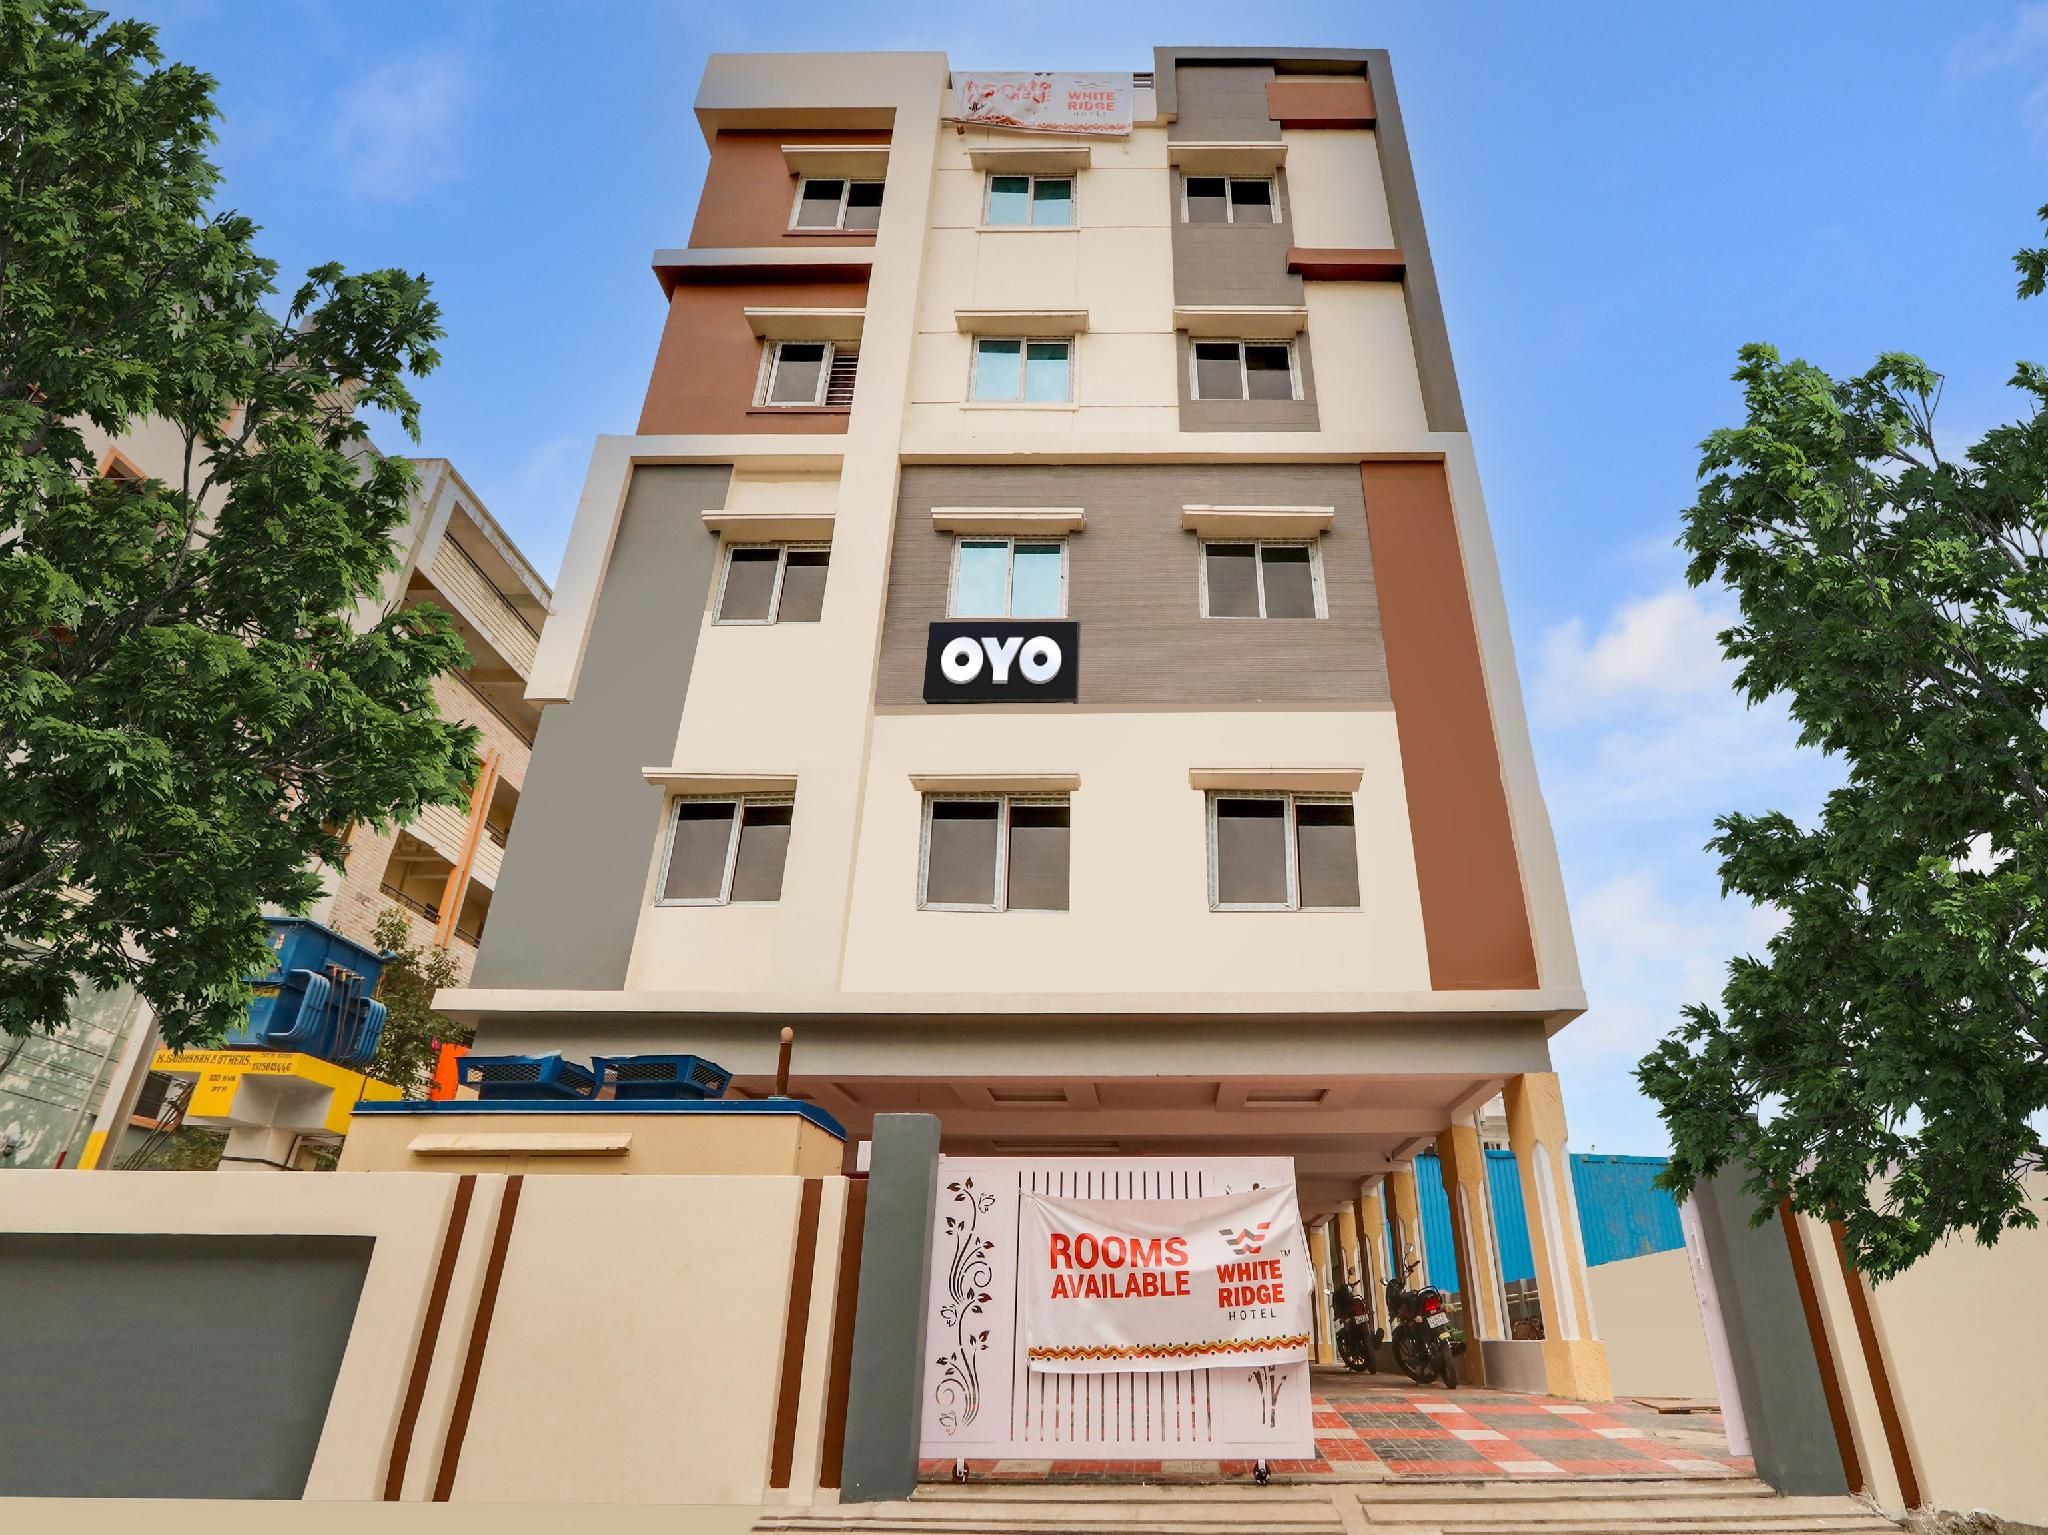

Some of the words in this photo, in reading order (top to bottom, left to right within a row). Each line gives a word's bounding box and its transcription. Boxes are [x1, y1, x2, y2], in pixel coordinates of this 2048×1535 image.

[1068, 91, 1115, 100] WHITE
[1068, 101, 1115, 111] RIDGE
[941, 635, 1062, 684] OYO
[1050, 1233, 1189, 1270] ROOMS
[1216, 1259, 1282, 1283] WHITE
[1051, 1270, 1190, 1299] AVAILABLE
[1218, 1283, 1285, 1308] RIDGE
[1228, 1308, 1277, 1320] HOTEL
